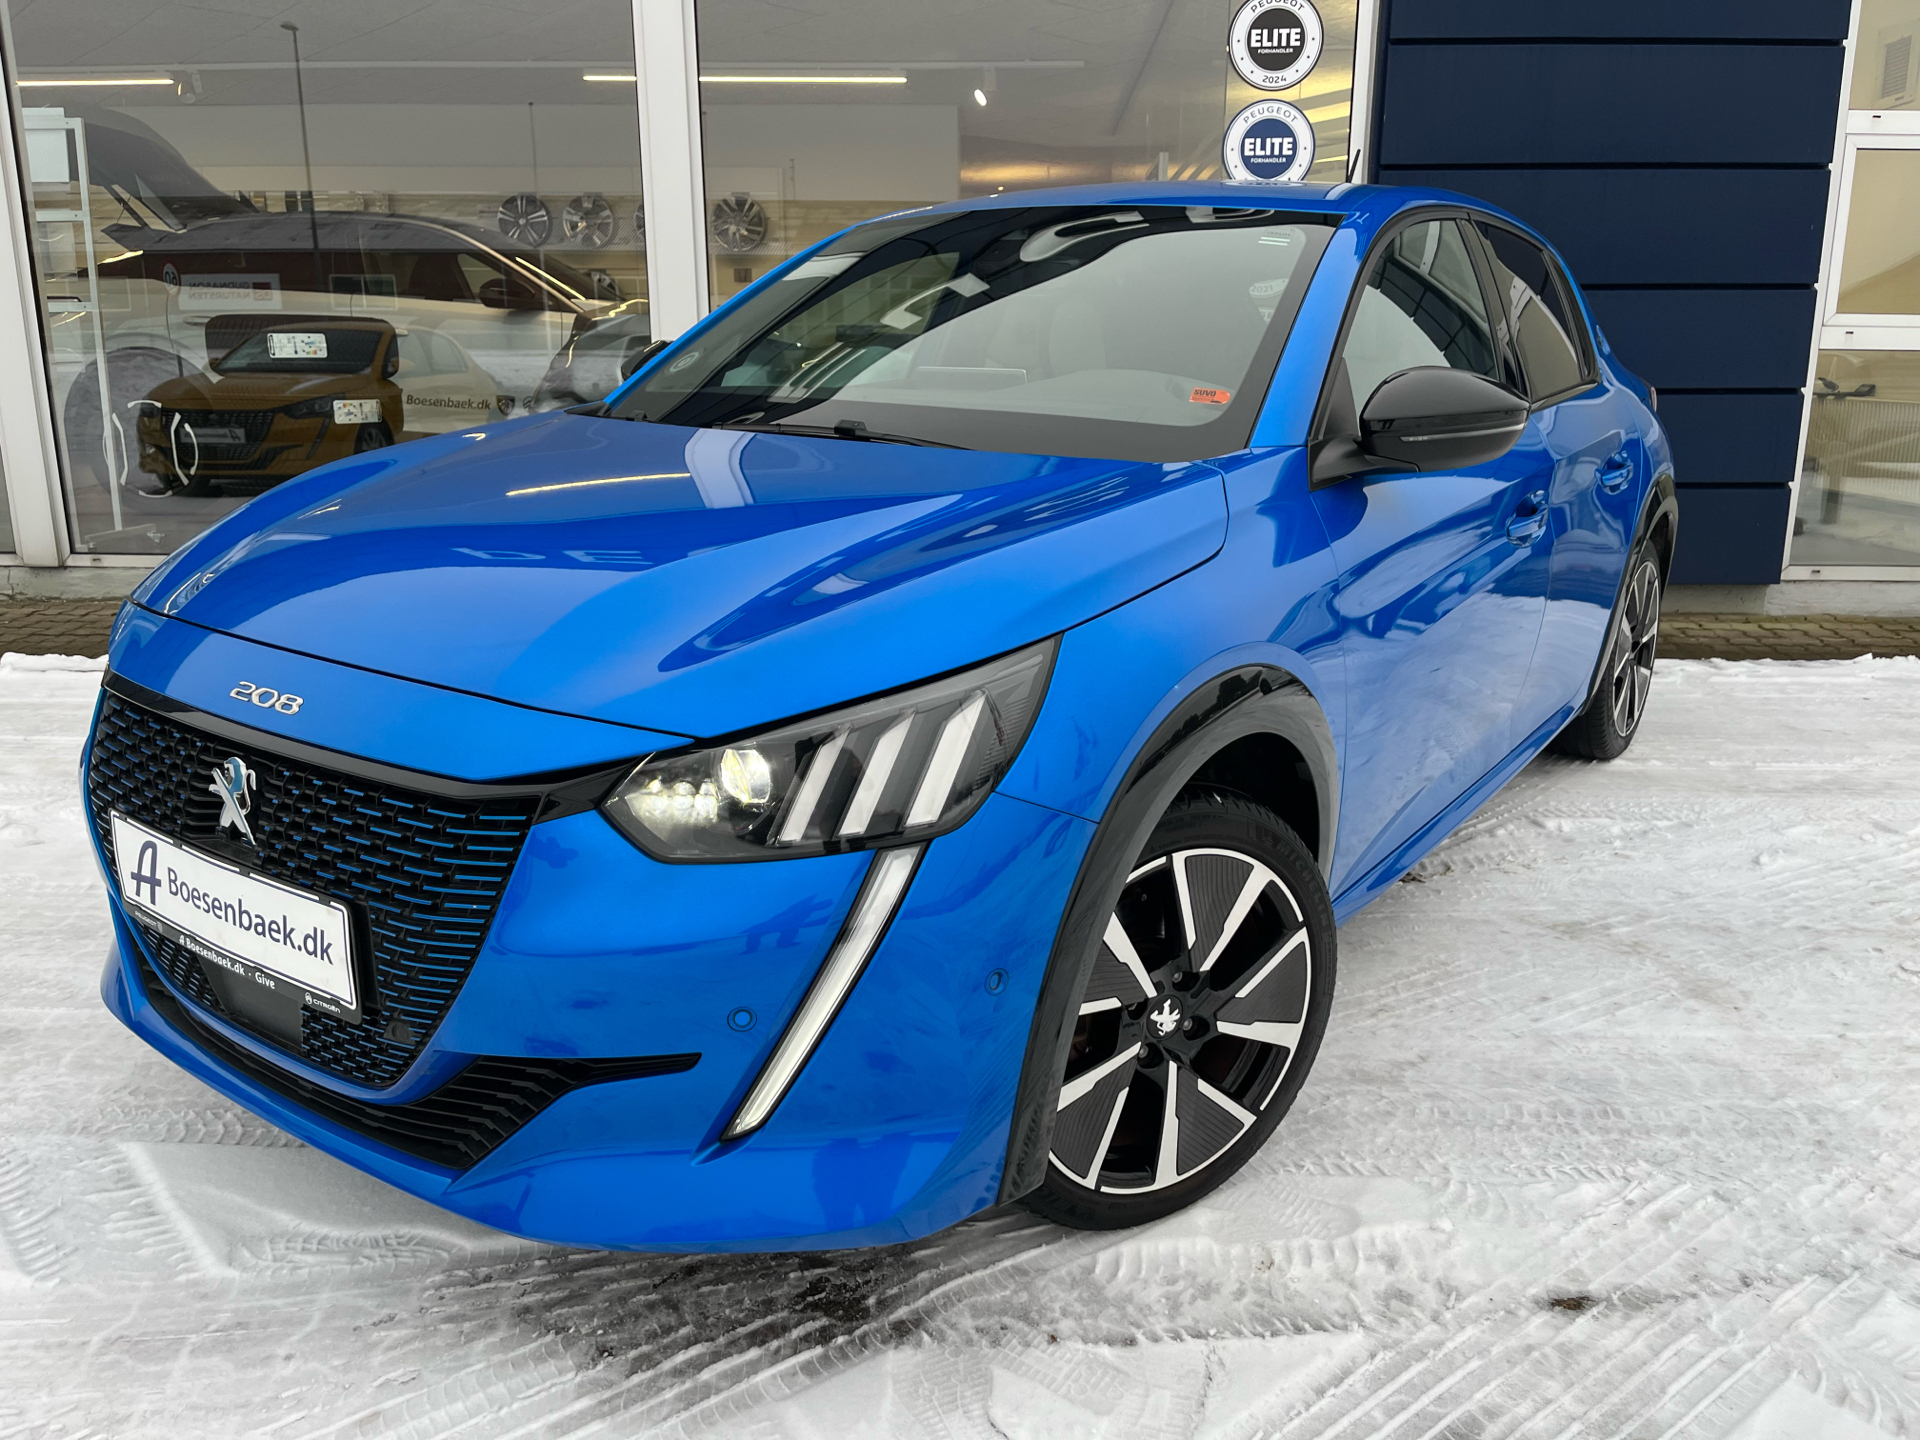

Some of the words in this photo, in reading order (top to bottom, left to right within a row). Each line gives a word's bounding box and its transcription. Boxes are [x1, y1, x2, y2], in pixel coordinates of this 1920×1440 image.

[1250, 28, 1301, 48] ELITE
[1262, 75, 1287, 84] 2024
[1243, 105, 1298, 124] PEUGEOT
[1243, 137, 1293, 156] ELITE
[1251, 284, 1274, 293] 2021
[406, 394, 491, 410] Boesenbaek.dk
[229, 681, 304, 715] 208
[1276, 839, 1330, 933] MICHELIN
[167, 866, 335, 966] Boesenbaek.dk
[186, 938, 245, 976] Boesenbaek.dk
[255, 971, 276, 990] Give
